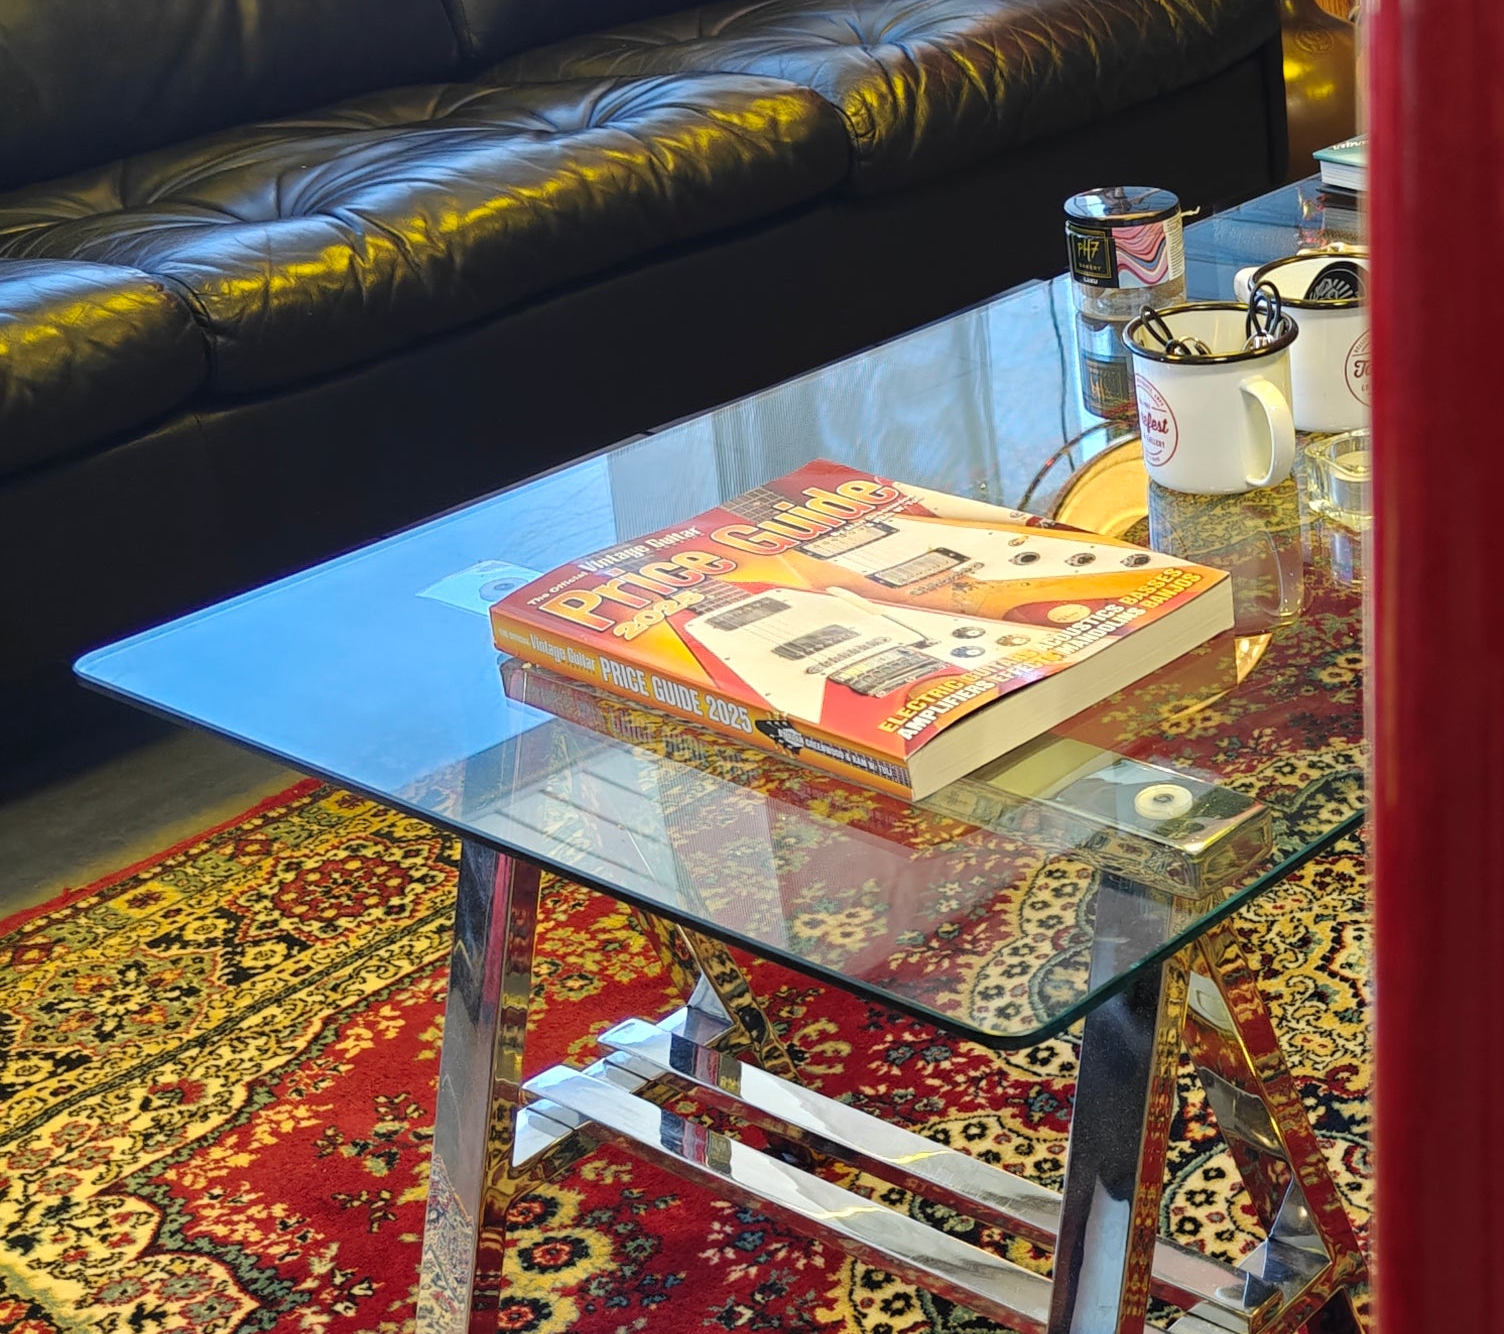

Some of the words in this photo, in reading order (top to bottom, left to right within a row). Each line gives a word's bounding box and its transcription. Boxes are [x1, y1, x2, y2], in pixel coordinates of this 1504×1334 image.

[527, 592, 549, 607] The
[548, 571, 588, 594] Official
[578, 543, 650, 574] Vintage
[645, 525, 703, 551] Guitar
[537, 550, 737, 632] Price
[709, 479, 900, 556] Guide
[612, 587, 706, 641] 2025
[529, 633, 565, 662] Vintage
[567, 646, 596, 672] Guitar
[599, 655, 649, 698] PRICE
[651, 675, 703, 717] GUIDE
[705, 694, 753, 734] 2025
[878, 679, 965, 733] ELECTRIC
[1037, 604, 1125, 651] ACOUSTICS
[1119, 567, 1183, 605] BASSES
[897, 679, 996, 741] AMPLIFIERS
[1055, 607, 1147, 655] MANDOLINS
[1140, 572, 1203, 609] BANJOS
